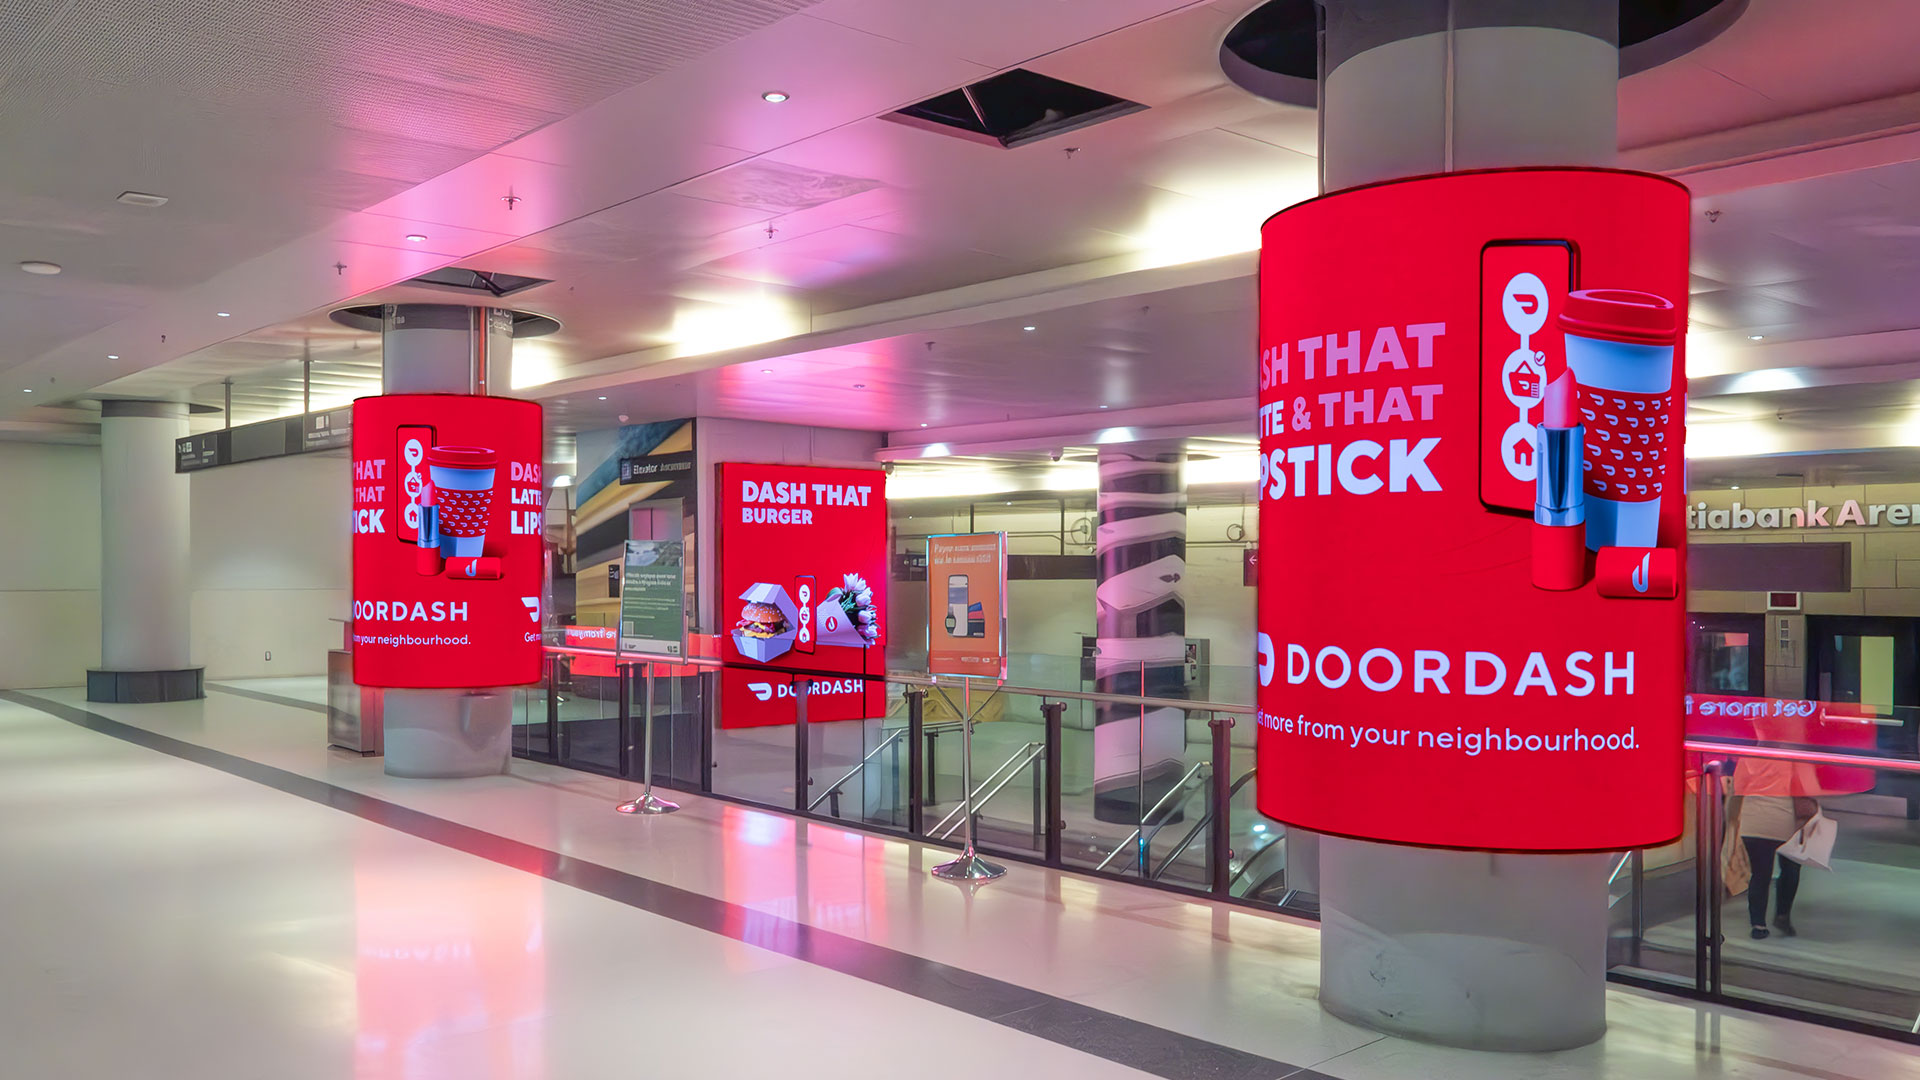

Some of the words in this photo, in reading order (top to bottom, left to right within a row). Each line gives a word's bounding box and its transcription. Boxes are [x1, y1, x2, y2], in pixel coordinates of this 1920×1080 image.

[1260, 342, 1289, 392] SH
[1298, 322, 1446, 381] THAT
[1291, 396, 1312, 432] &
[1318, 384, 1444, 428] THAT
[355, 485, 385, 503] THAT
[742, 480, 807, 505] DASH
[811, 484, 872, 507] THAT
[742, 507, 813, 525] BURGER
[1687, 499, 1830, 530] tiabank
[352, 600, 468, 622] OORDASH
[377, 633, 472, 648] neighbourhood.
[1286, 643, 1635, 697] DOORDASH
[777, 679, 864, 698] DORDASH
[1264, 713, 1294, 734] more
[1297, 714, 1345, 741] from
[1350, 724, 1411, 750] your
[1417, 726, 1640, 757] neighbourhood.
